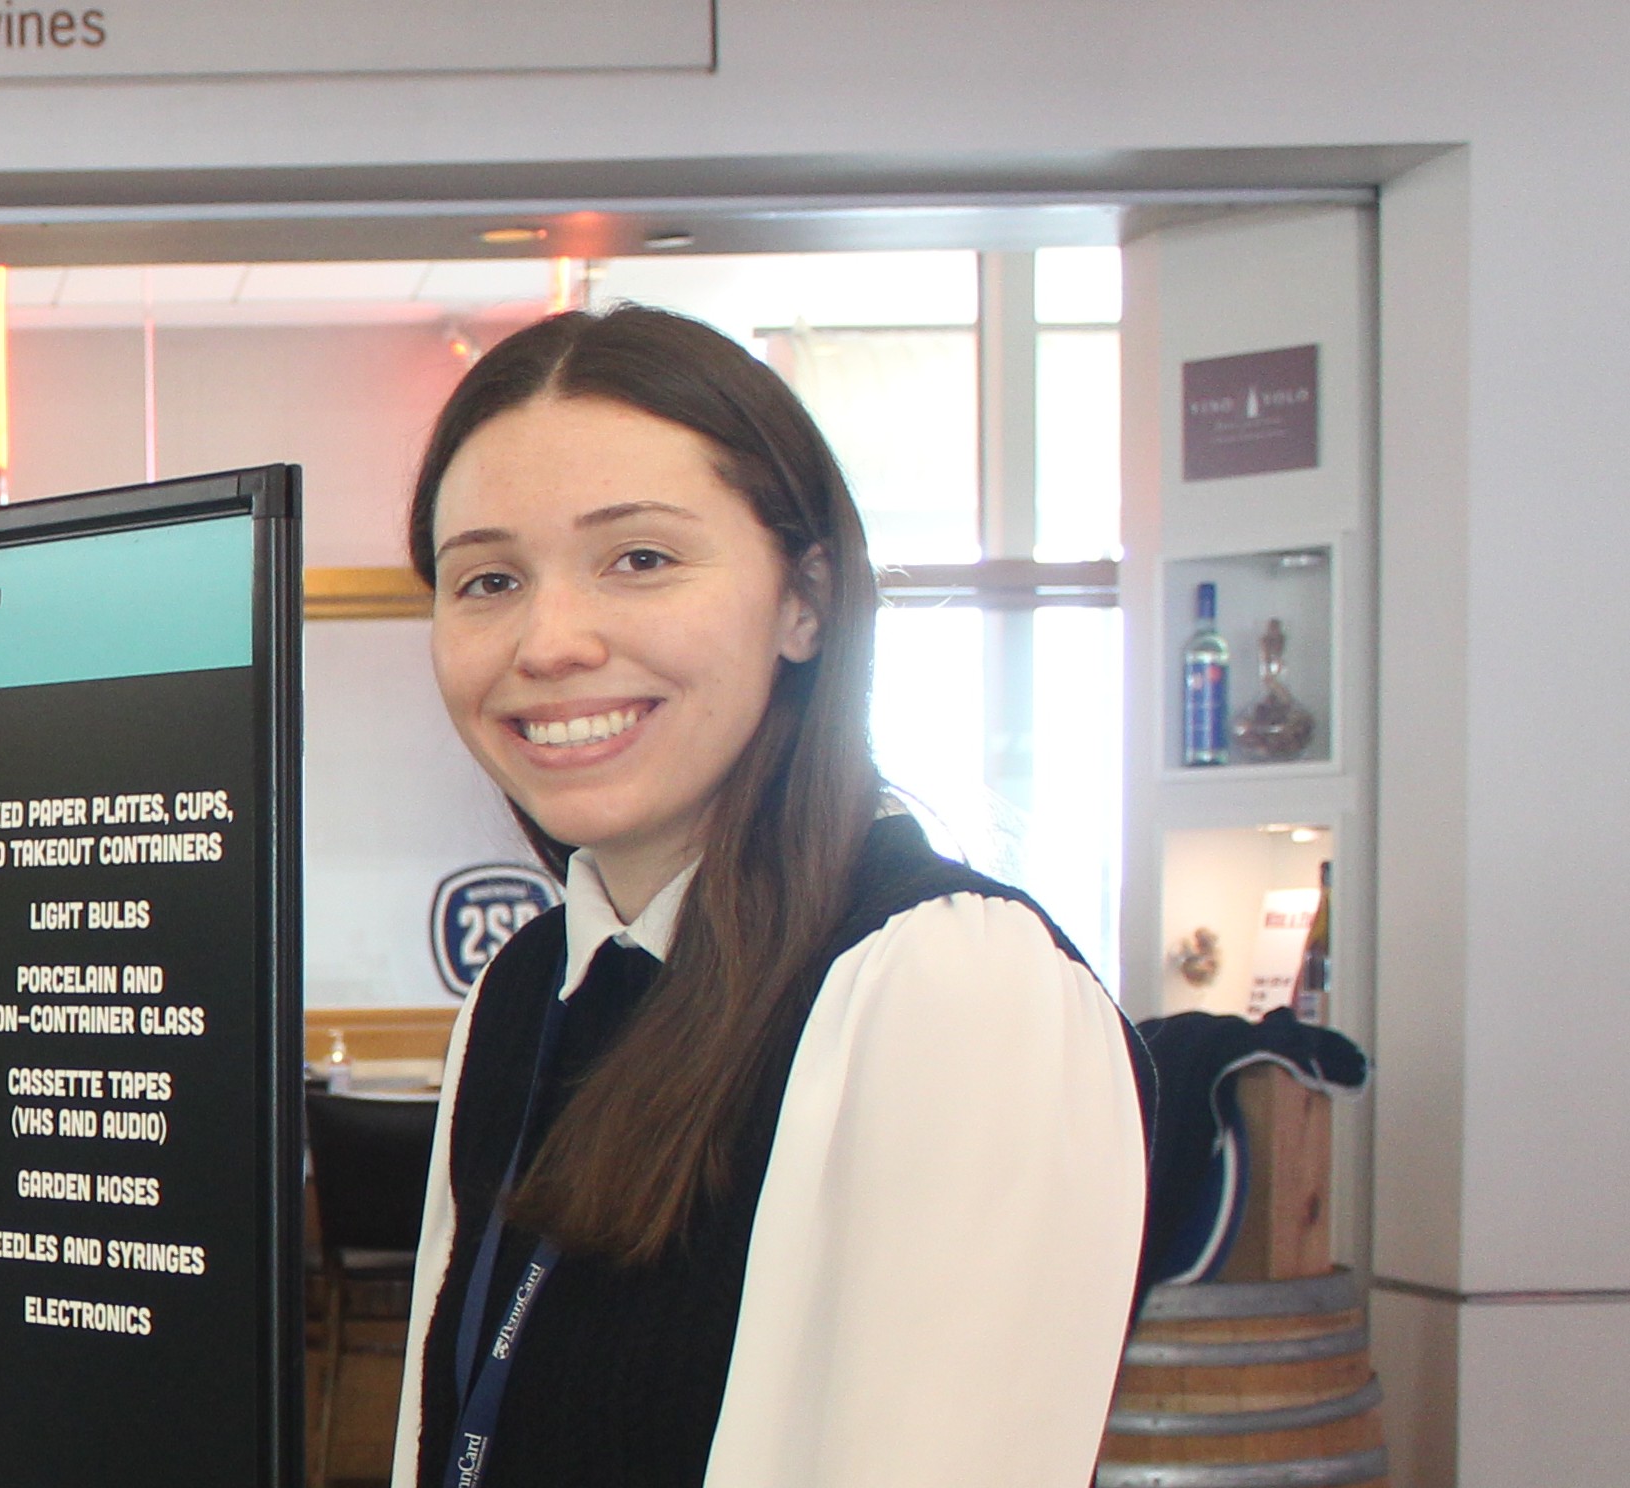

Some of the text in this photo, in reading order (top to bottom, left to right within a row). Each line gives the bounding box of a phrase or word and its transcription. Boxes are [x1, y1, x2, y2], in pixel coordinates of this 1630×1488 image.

[28, 797, 88, 828] PAPER
[92, 793, 170, 826] PLATES,
[174, 789, 234, 823] CUPS,
[9, 836, 95, 868] TAKEOUT
[99, 831, 223, 865] CONTAINERS
[30, 899, 151, 930] LIGHT BULBS
[17, 965, 164, 994] PORCELAIN AND
[140, 1006, 205, 1036] GLASS
[8, 1067, 172, 1101] CASSETTE TAPES
[11, 1105, 167, 1146] (VHS AND AUDIO)
[17, 1169, 160, 1207] GARDEN HOSES
[63, 1235, 102, 1266] AND
[106, 1239, 206, 1275] SYRINGES
[24, 1295, 152, 1336] ELECTRONICS
[499, 1263, 542, 1339] PennCard
